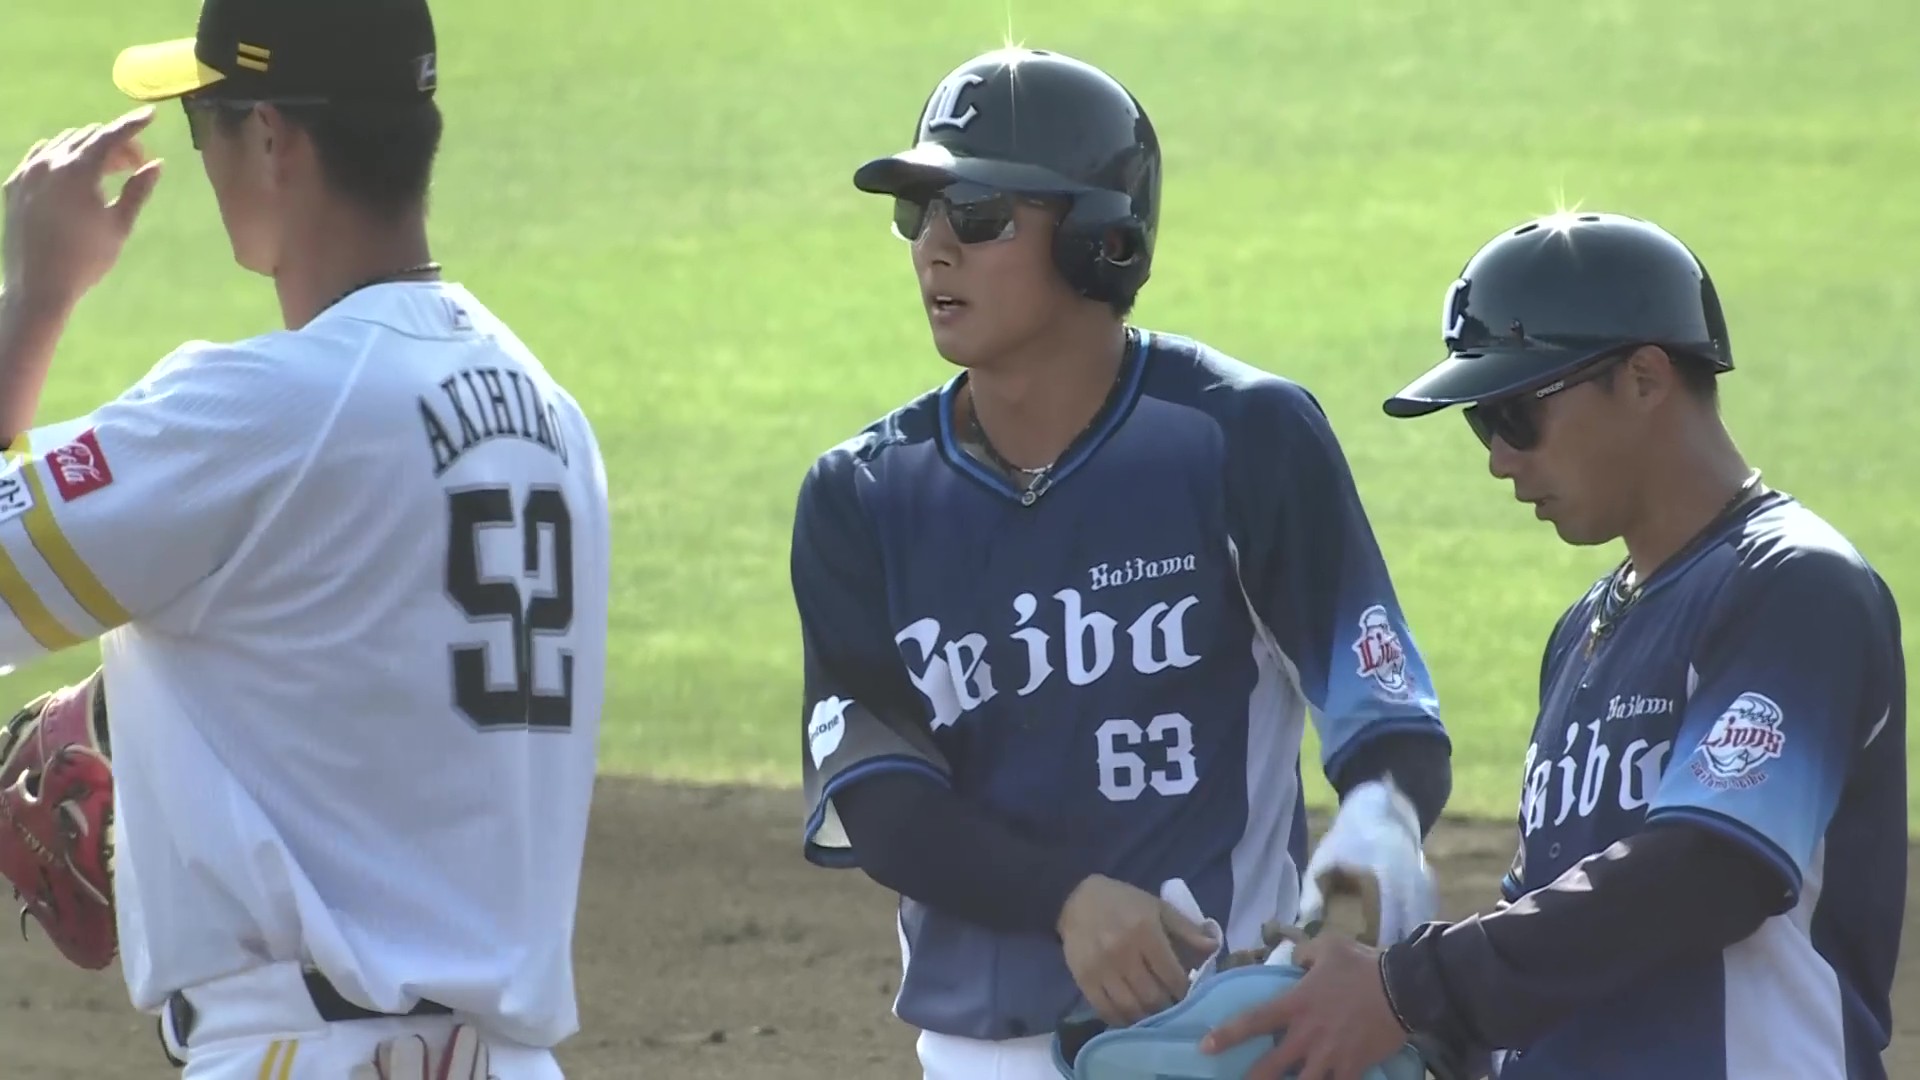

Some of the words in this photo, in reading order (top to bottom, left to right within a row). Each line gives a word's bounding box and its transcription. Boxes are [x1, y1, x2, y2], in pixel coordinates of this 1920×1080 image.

[417, 367, 569, 478] AKIHIKO
[446, 483, 574, 733] 52
[1089, 553, 1197, 590] Saitama
[895, 588, 1202, 732] Seibu
[1094, 712, 1199, 802] 63
